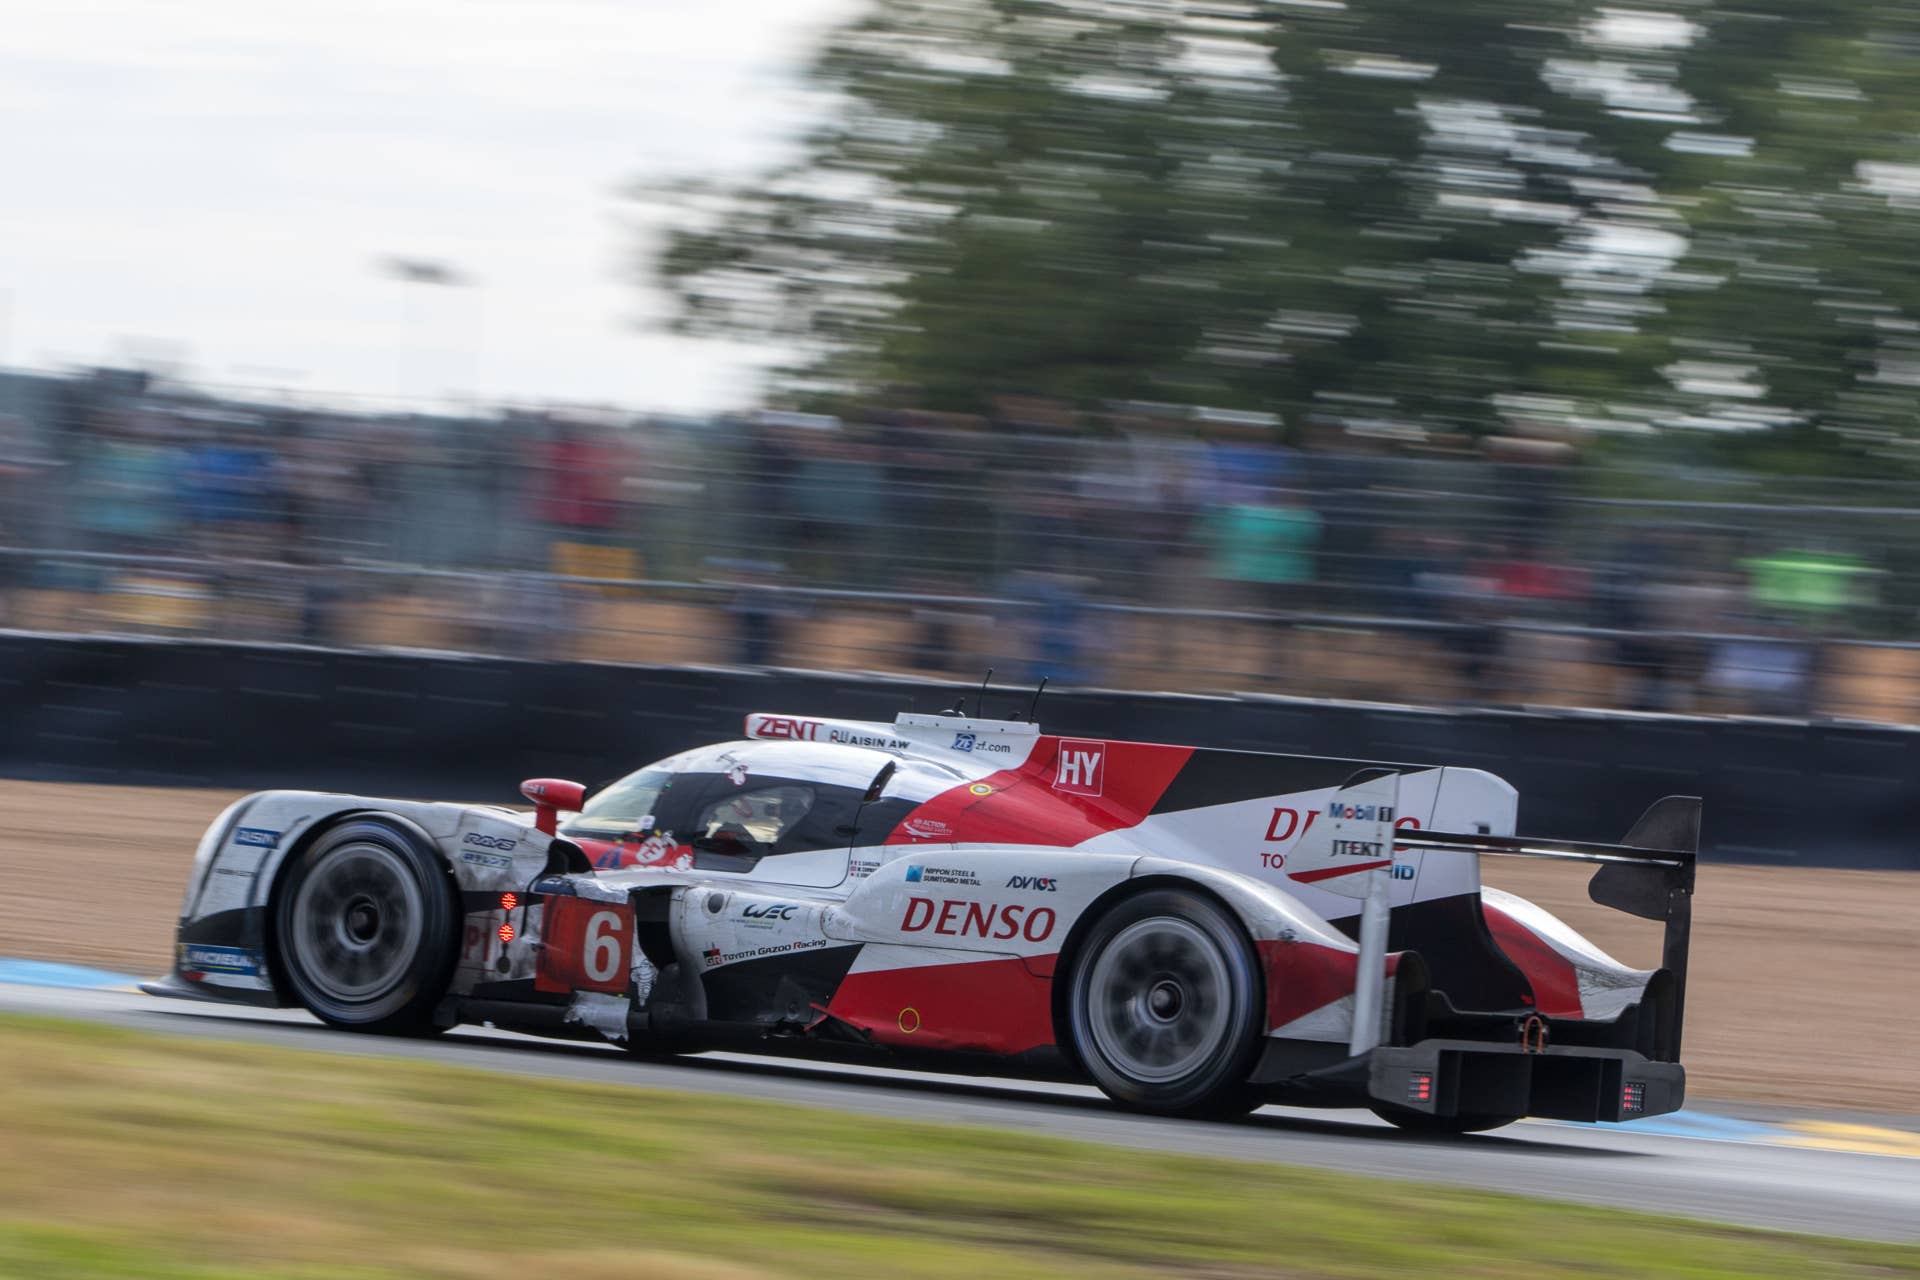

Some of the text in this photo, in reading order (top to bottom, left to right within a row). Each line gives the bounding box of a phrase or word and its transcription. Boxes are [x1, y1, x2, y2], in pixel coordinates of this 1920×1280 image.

[756, 717, 824, 742] ZENT
[850, 735, 886, 748] AISIN
[888, 740, 911, 749] AW
[975, 741, 1010, 753] zf.com
[1058, 750, 1101, 786] HY
[1329, 802, 1393, 822] Mobil 1
[463, 832, 517, 851] RAYS
[1330, 840, 1384, 857] JTEKT
[923, 875, 981, 887] SUMITOMO METAL
[925, 867, 950, 876] NIPPON
[951, 869, 970, 877] STEEL
[742, 904, 799, 920] WEC
[900, 897, 1056, 943] DENSO
[583, 910, 623, 982] 6
[722, 950, 757, 961] TOYOTA
[758, 944, 792, 958] GAZOO
[793, 939, 827, 951] Racing
